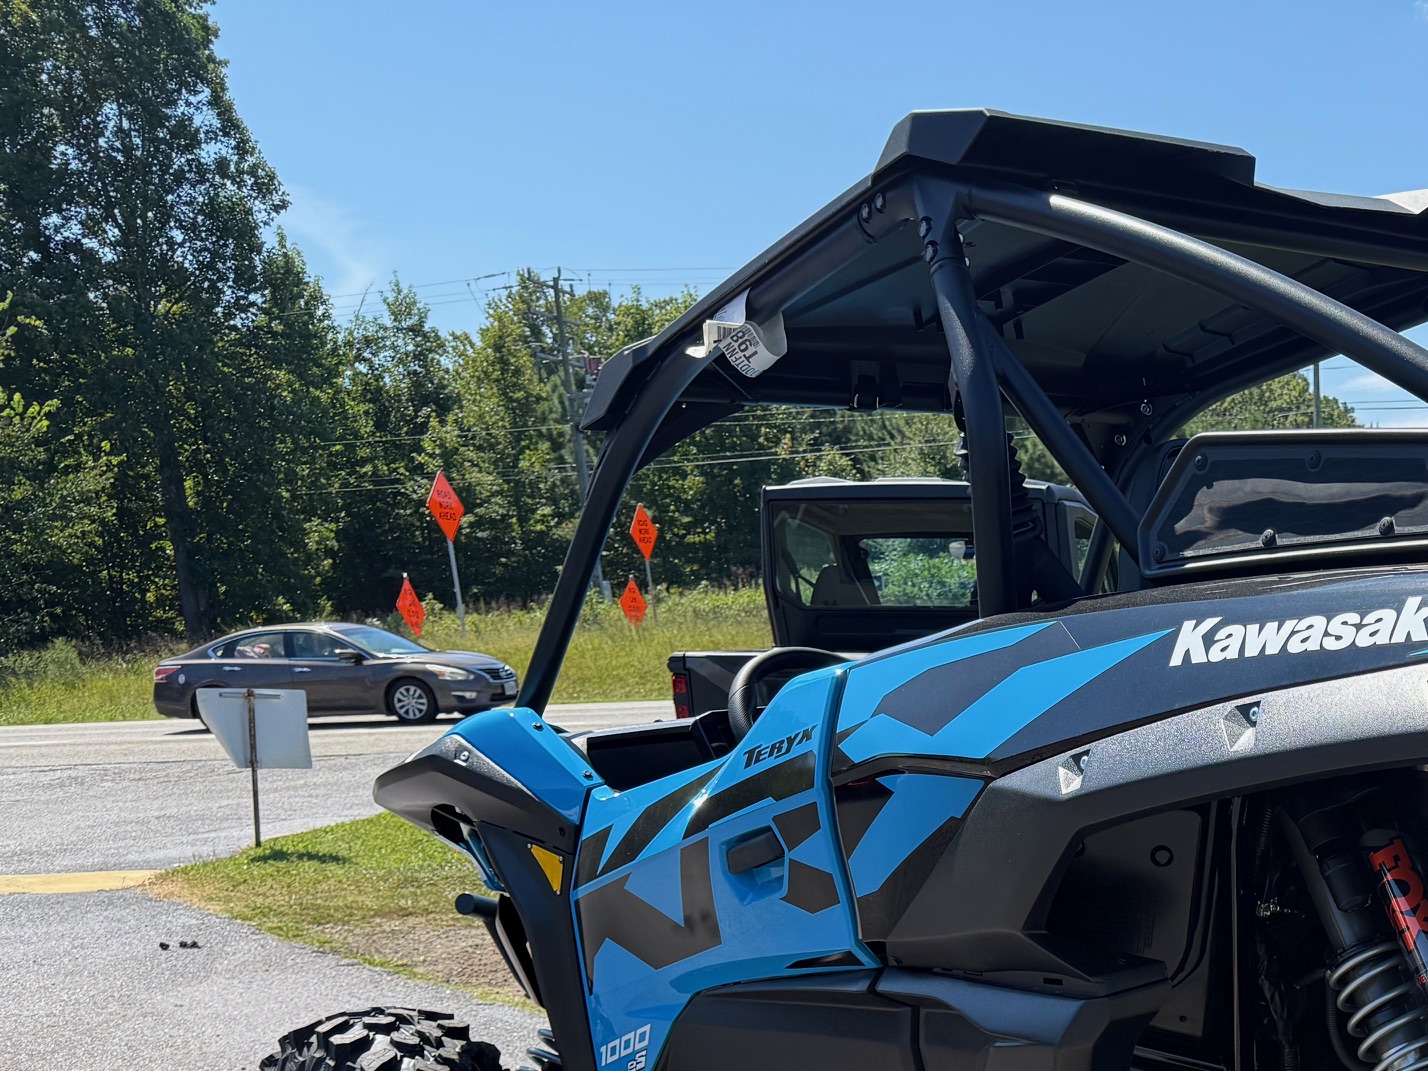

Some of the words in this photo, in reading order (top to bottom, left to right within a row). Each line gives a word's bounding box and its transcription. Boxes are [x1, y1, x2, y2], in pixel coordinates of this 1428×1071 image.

[436, 489, 451, 500] ROAD
[438, 511, 457, 521] AHEAD
[743, 724, 818, 770] TERYX
[600, 1023, 651, 1067] 1000
